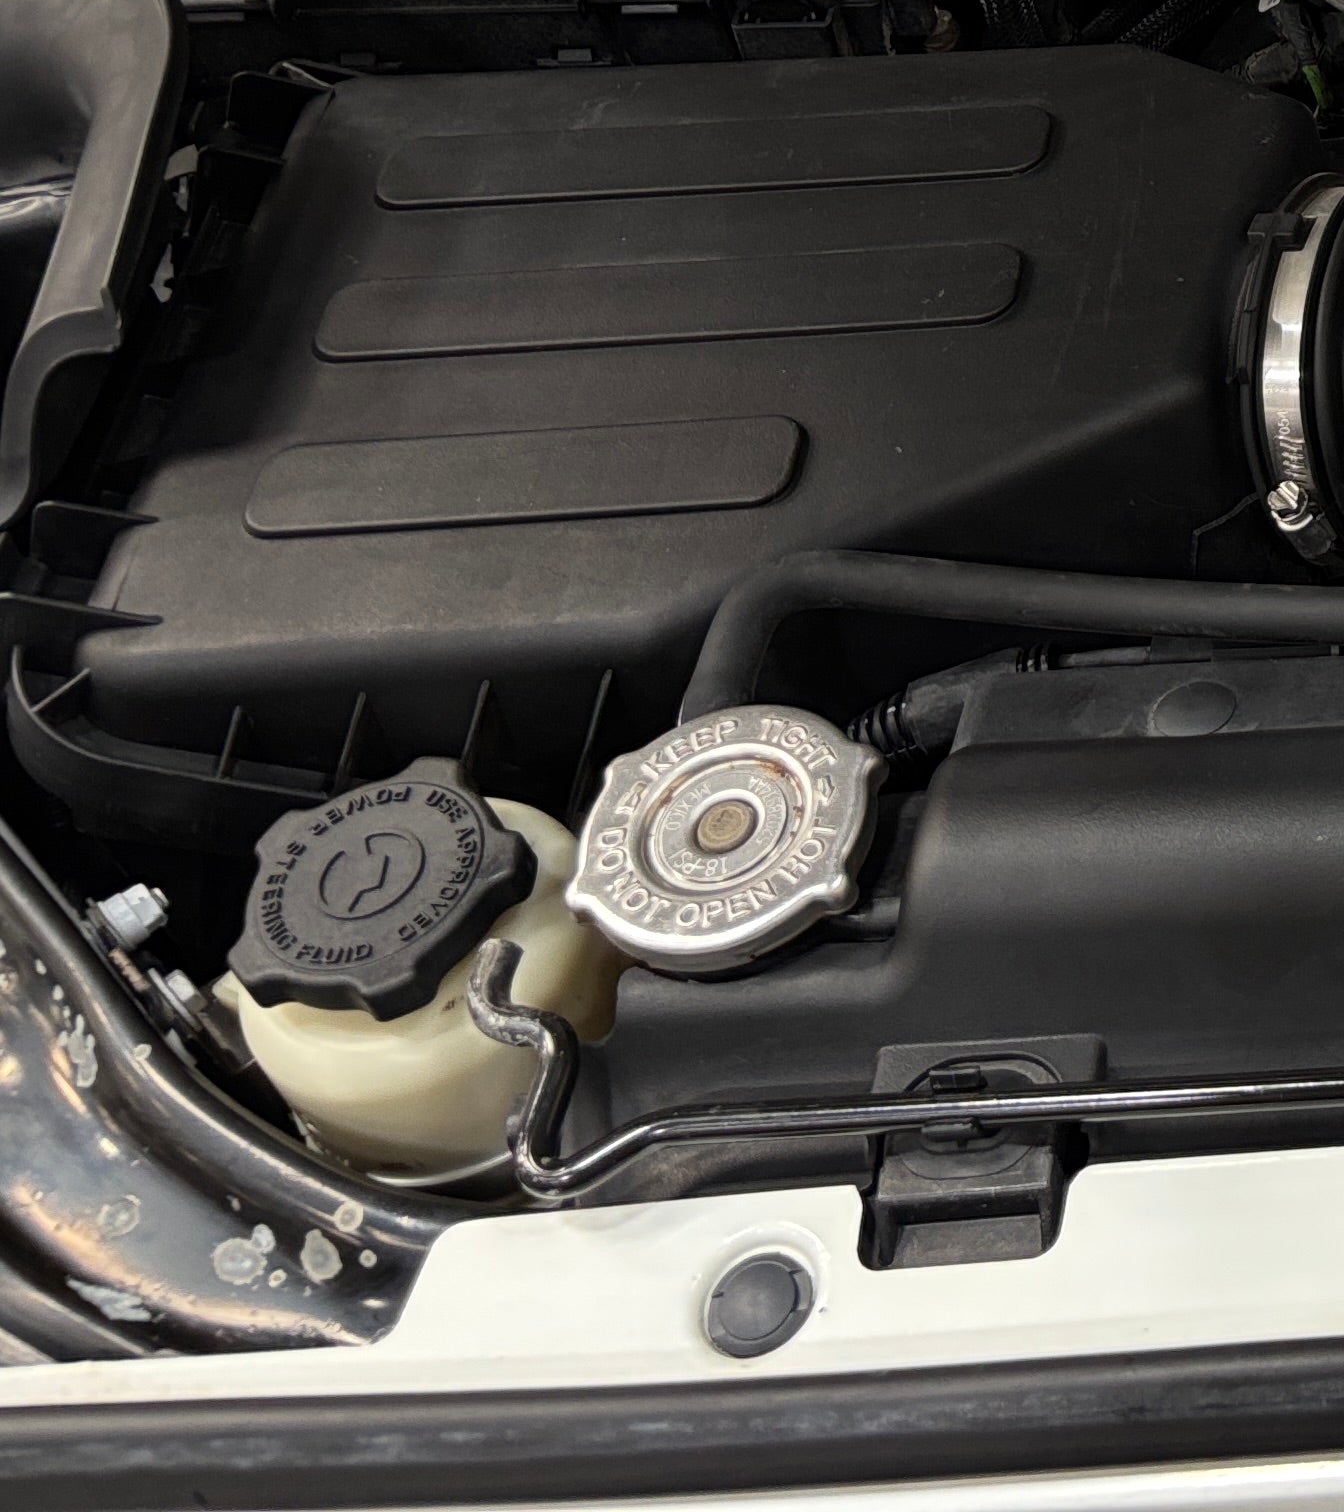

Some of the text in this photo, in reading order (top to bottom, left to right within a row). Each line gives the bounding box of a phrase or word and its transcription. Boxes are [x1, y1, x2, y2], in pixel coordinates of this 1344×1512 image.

[640, 717, 839, 780] KEEP TIGHT
[664, 782, 712, 831] MEXICO
[261, 786, 413, 965] POWER STEERING FLUID
[398, 790, 478, 942] USE APPROVED
[599, 818, 837, 928] DO NOT OPEN HOT
